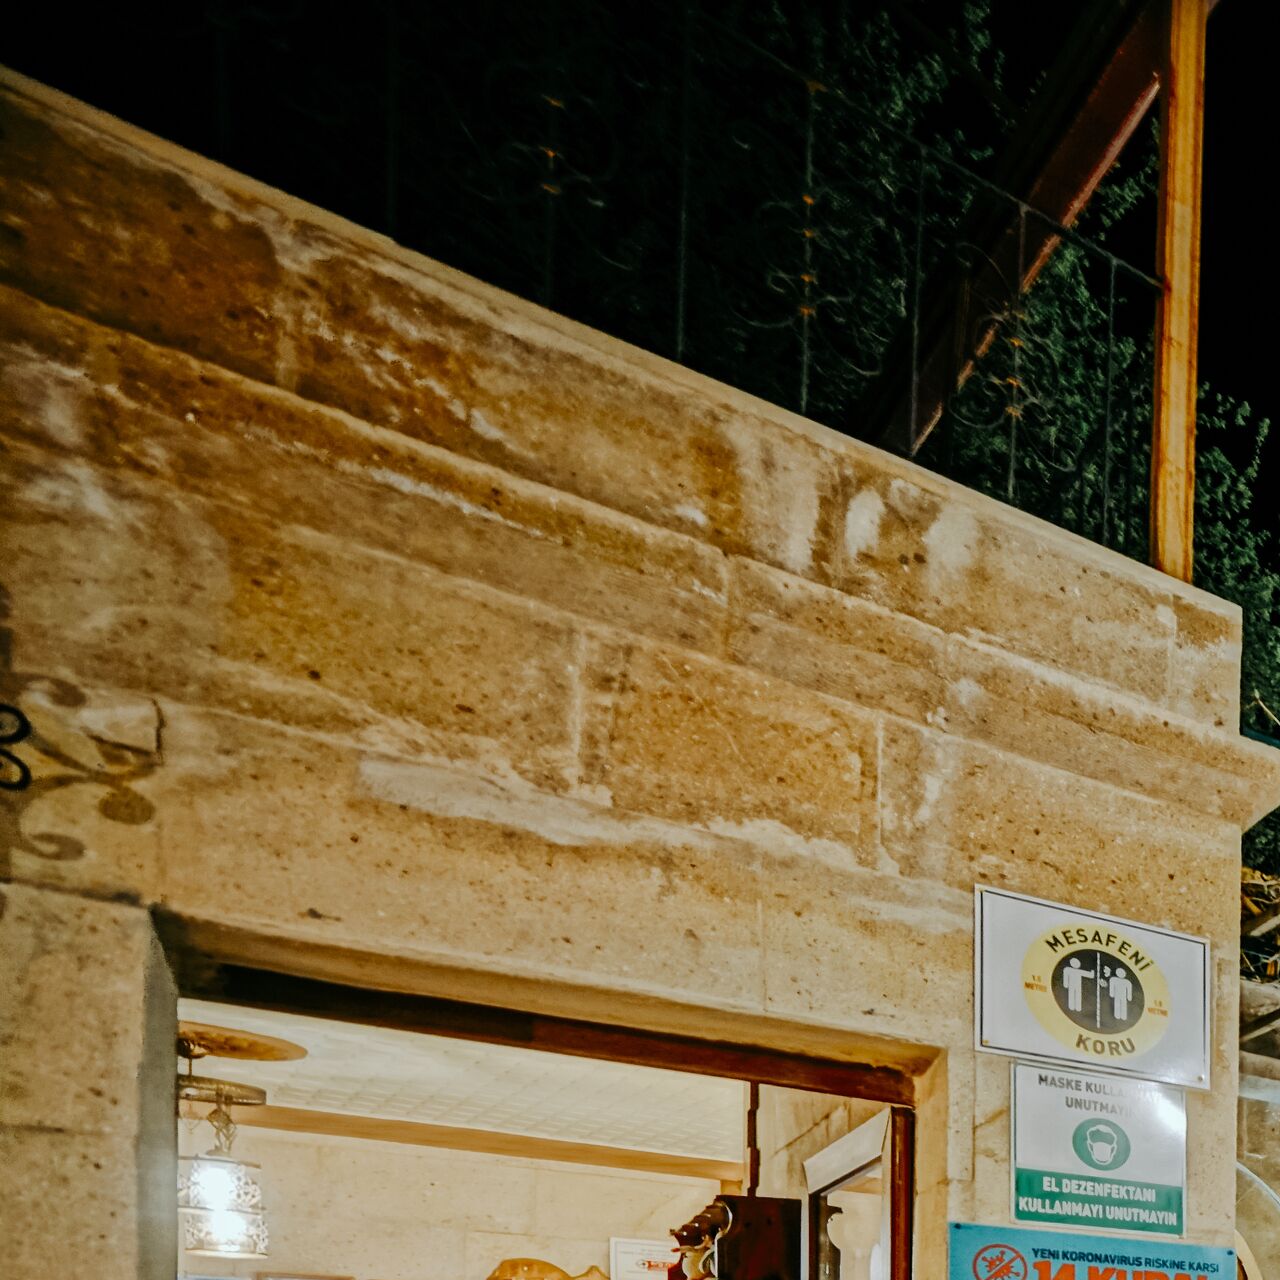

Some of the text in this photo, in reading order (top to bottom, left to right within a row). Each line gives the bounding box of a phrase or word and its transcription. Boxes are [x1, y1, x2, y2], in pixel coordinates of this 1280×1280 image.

[1045, 928, 1155, 972] MESAFENİ
[1075, 1033, 1136, 1056] KORU
[1038, 1073, 1083, 1092] MASKE
[1042, 1176, 1156, 1203] EL DEZENFEKTANI
[1018, 1196, 1177, 1226] KULLANMAYI UNUTMAYIN
